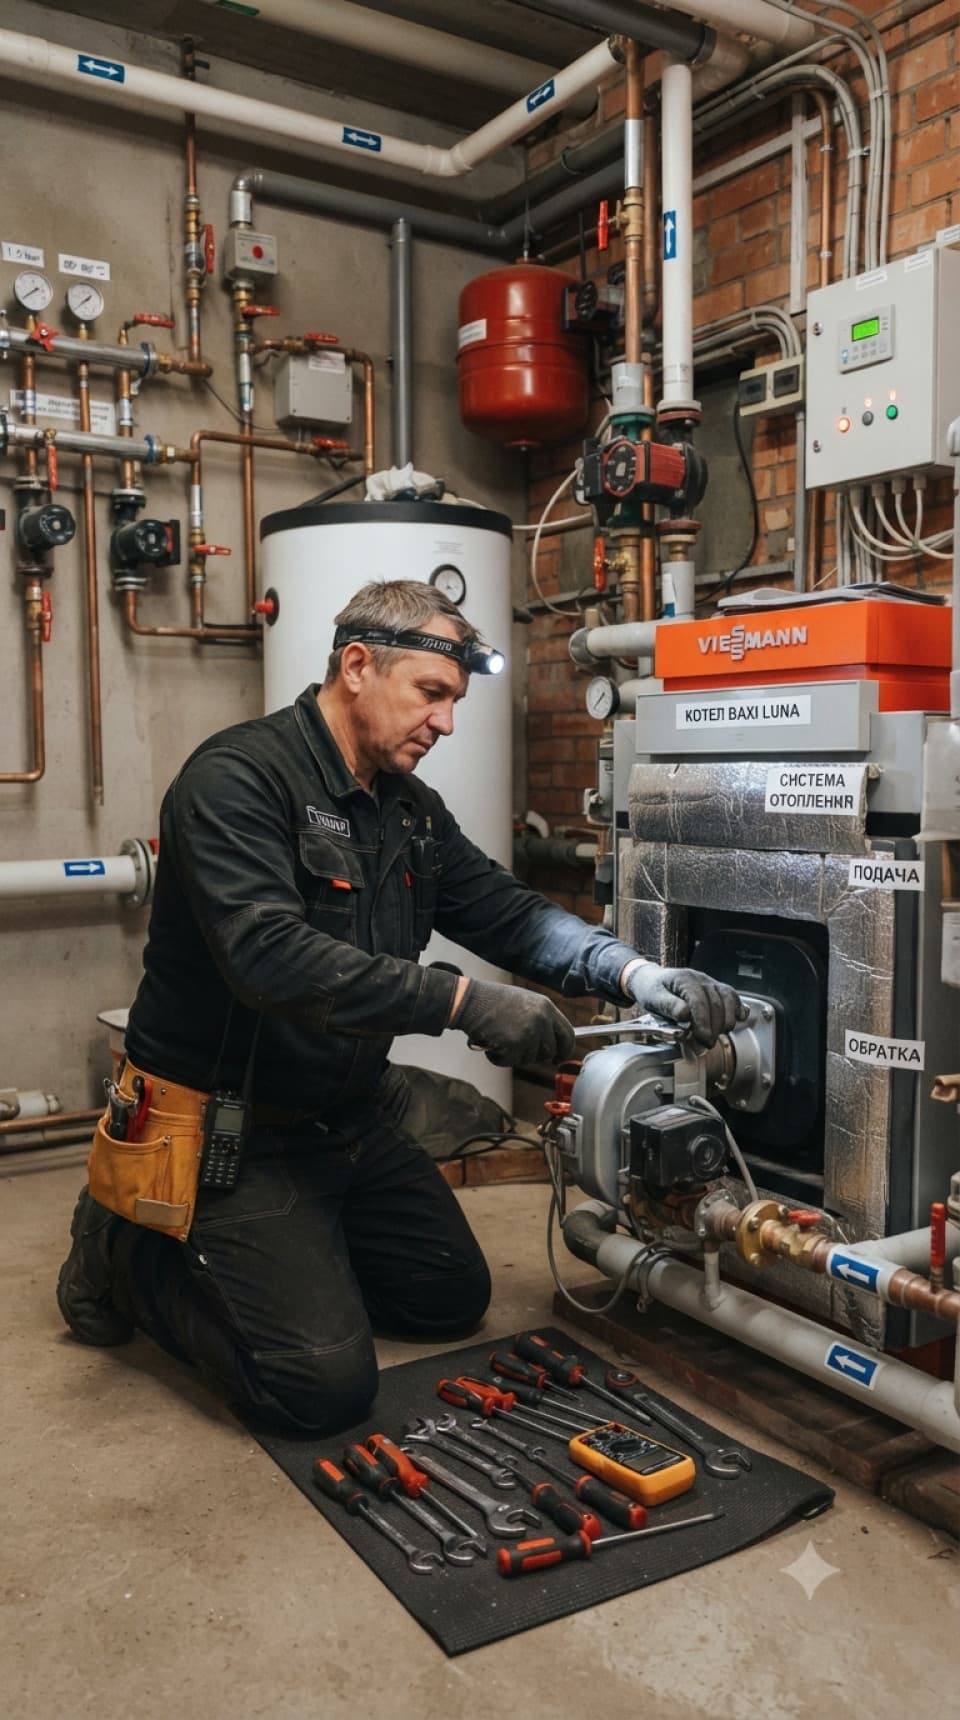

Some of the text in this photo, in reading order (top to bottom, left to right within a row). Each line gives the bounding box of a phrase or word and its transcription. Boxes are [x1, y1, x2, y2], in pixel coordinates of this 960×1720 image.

[698, 625, 807, 660] VIESSMANN
[685, 704, 800, 722] КОТЕЛ BAXI LUNA
[854, 865, 920, 883] ПОДАЧА
[849, 1038, 921, 1062] ОБРАТКА
